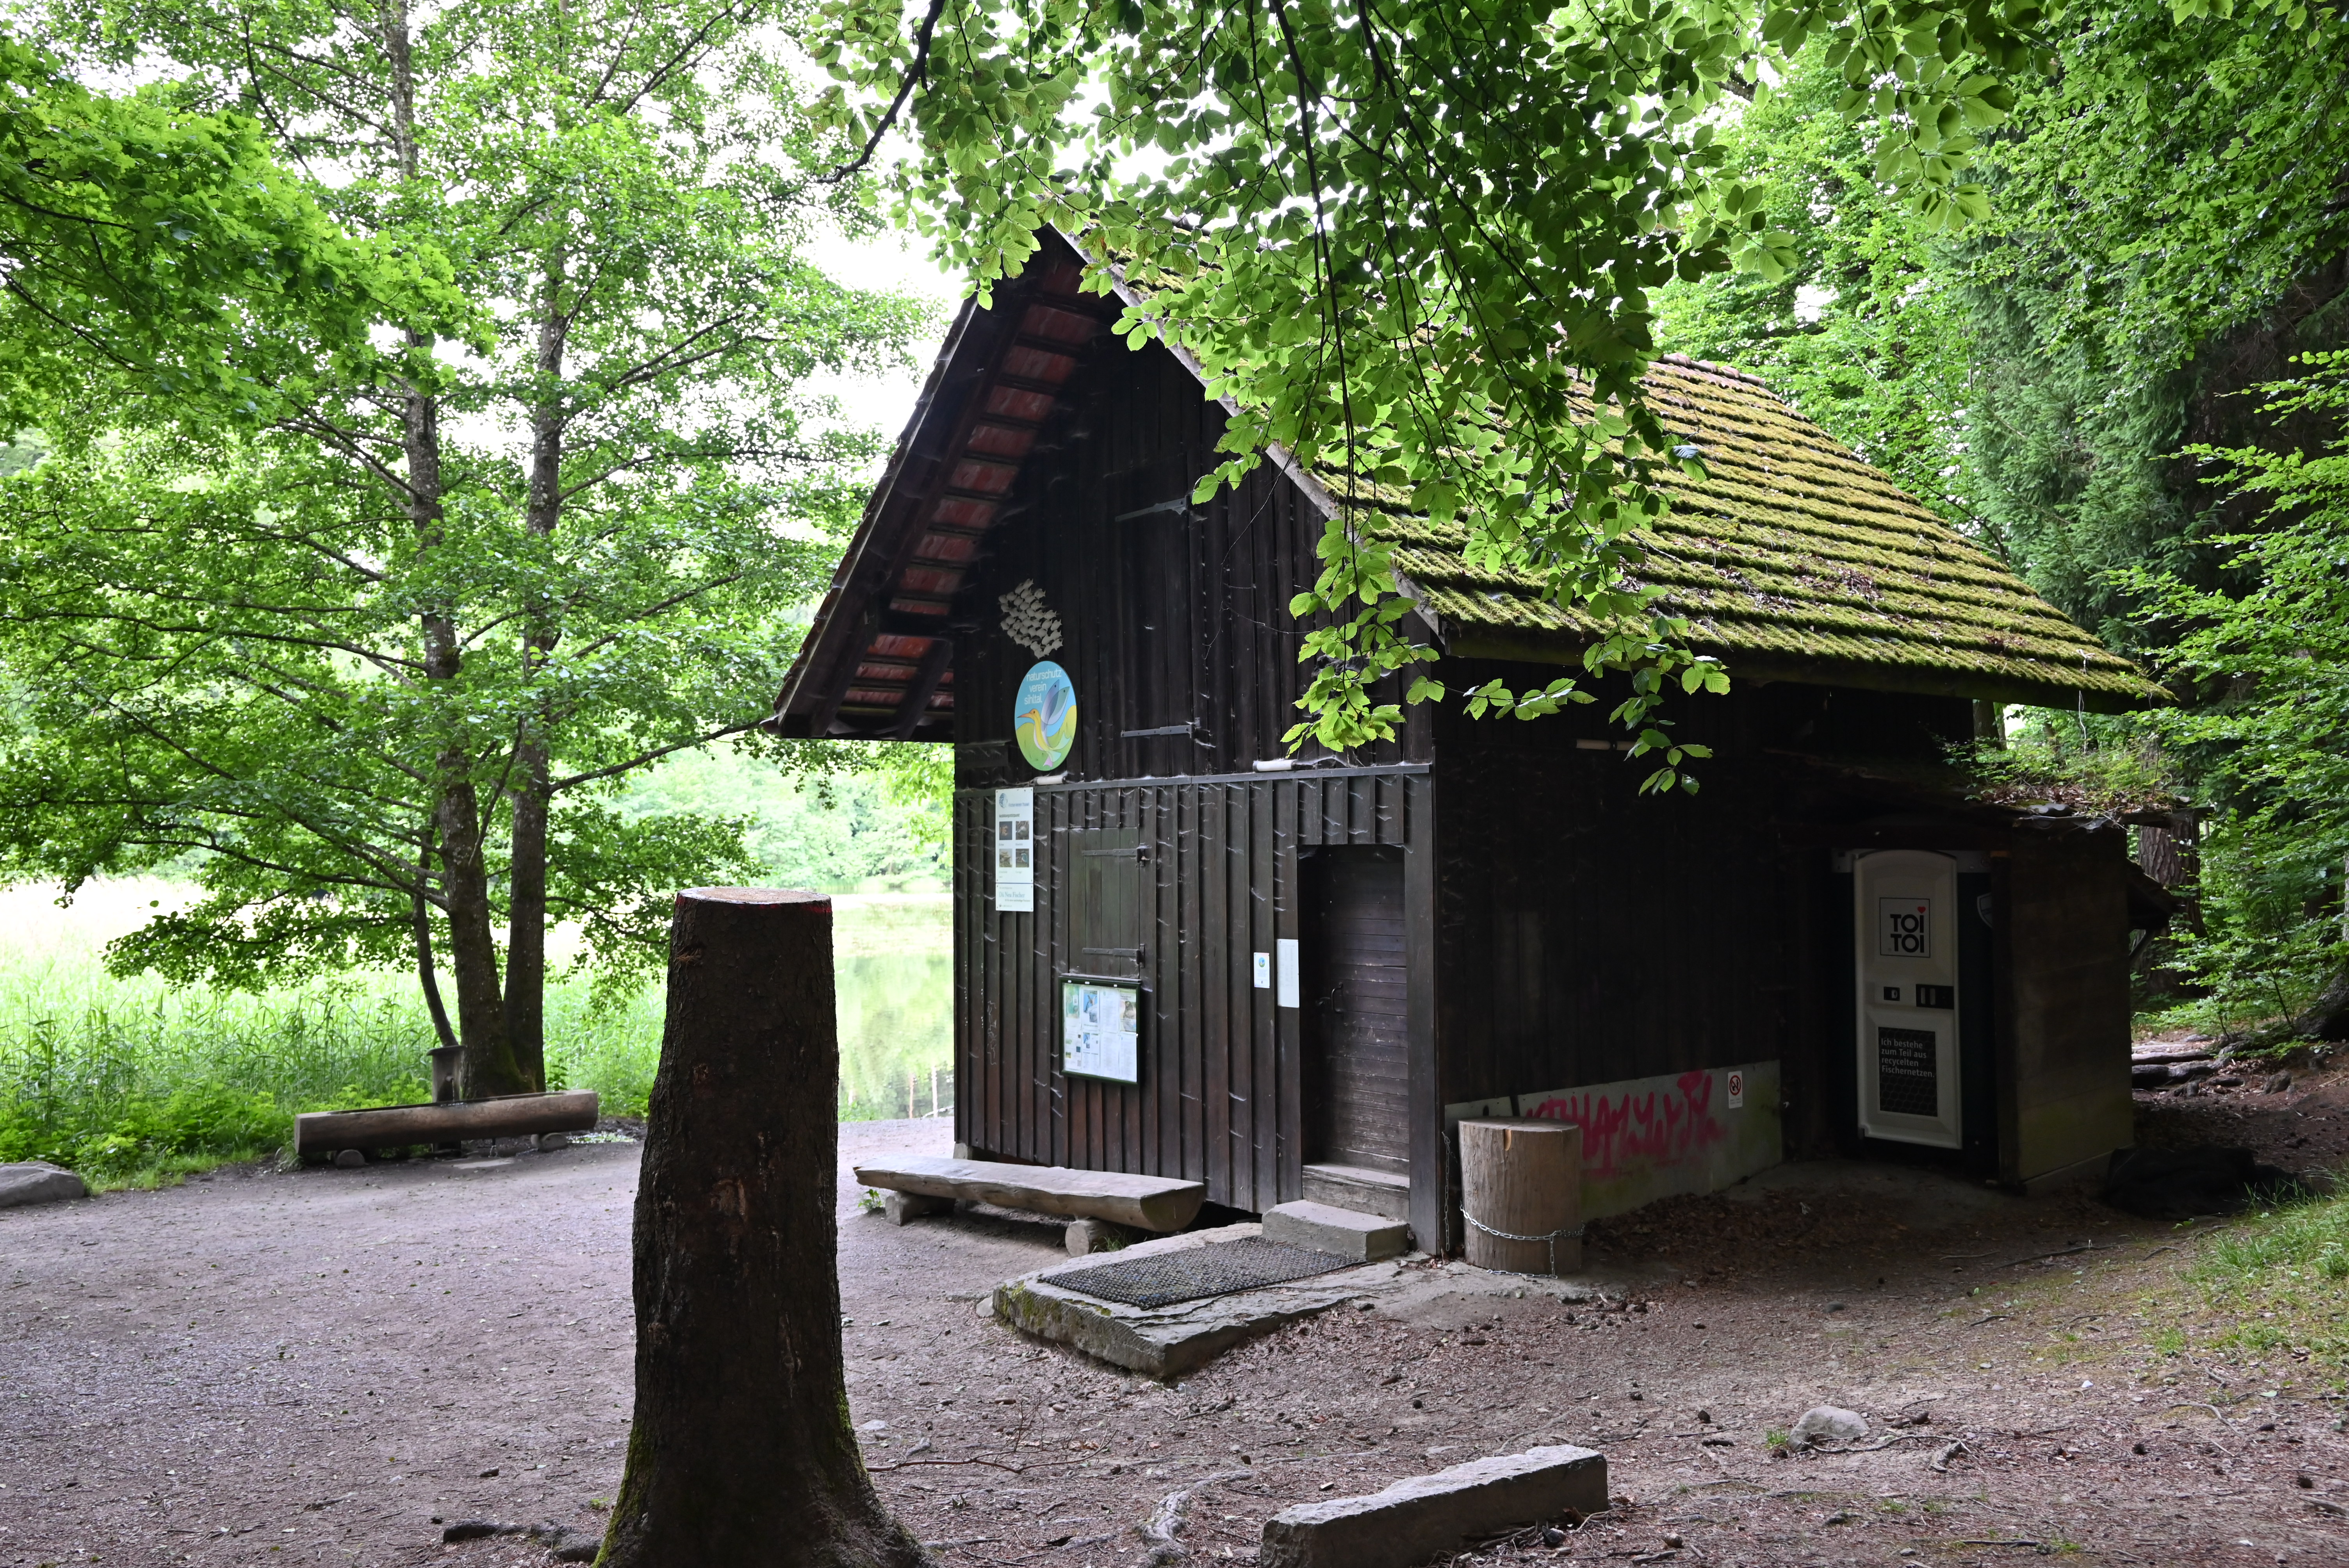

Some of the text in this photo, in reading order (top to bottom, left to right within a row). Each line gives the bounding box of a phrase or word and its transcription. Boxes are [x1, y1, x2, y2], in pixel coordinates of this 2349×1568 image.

[1027, 668, 1062, 681] naturschutz
[1029, 681, 1046, 692] verein
[1024, 693, 1043, 705] sihltal
[1890, 914, 1924, 933] TOI
[1890, 934, 1924, 953] TOI
[1881, 1038, 1923, 1049] Ich bestehe
[1899, 1048, 1911, 1057] Teil
[1882, 1057, 1919, 1067] recycelten
[1882, 1066, 1935, 1078] Fischernetzen.
